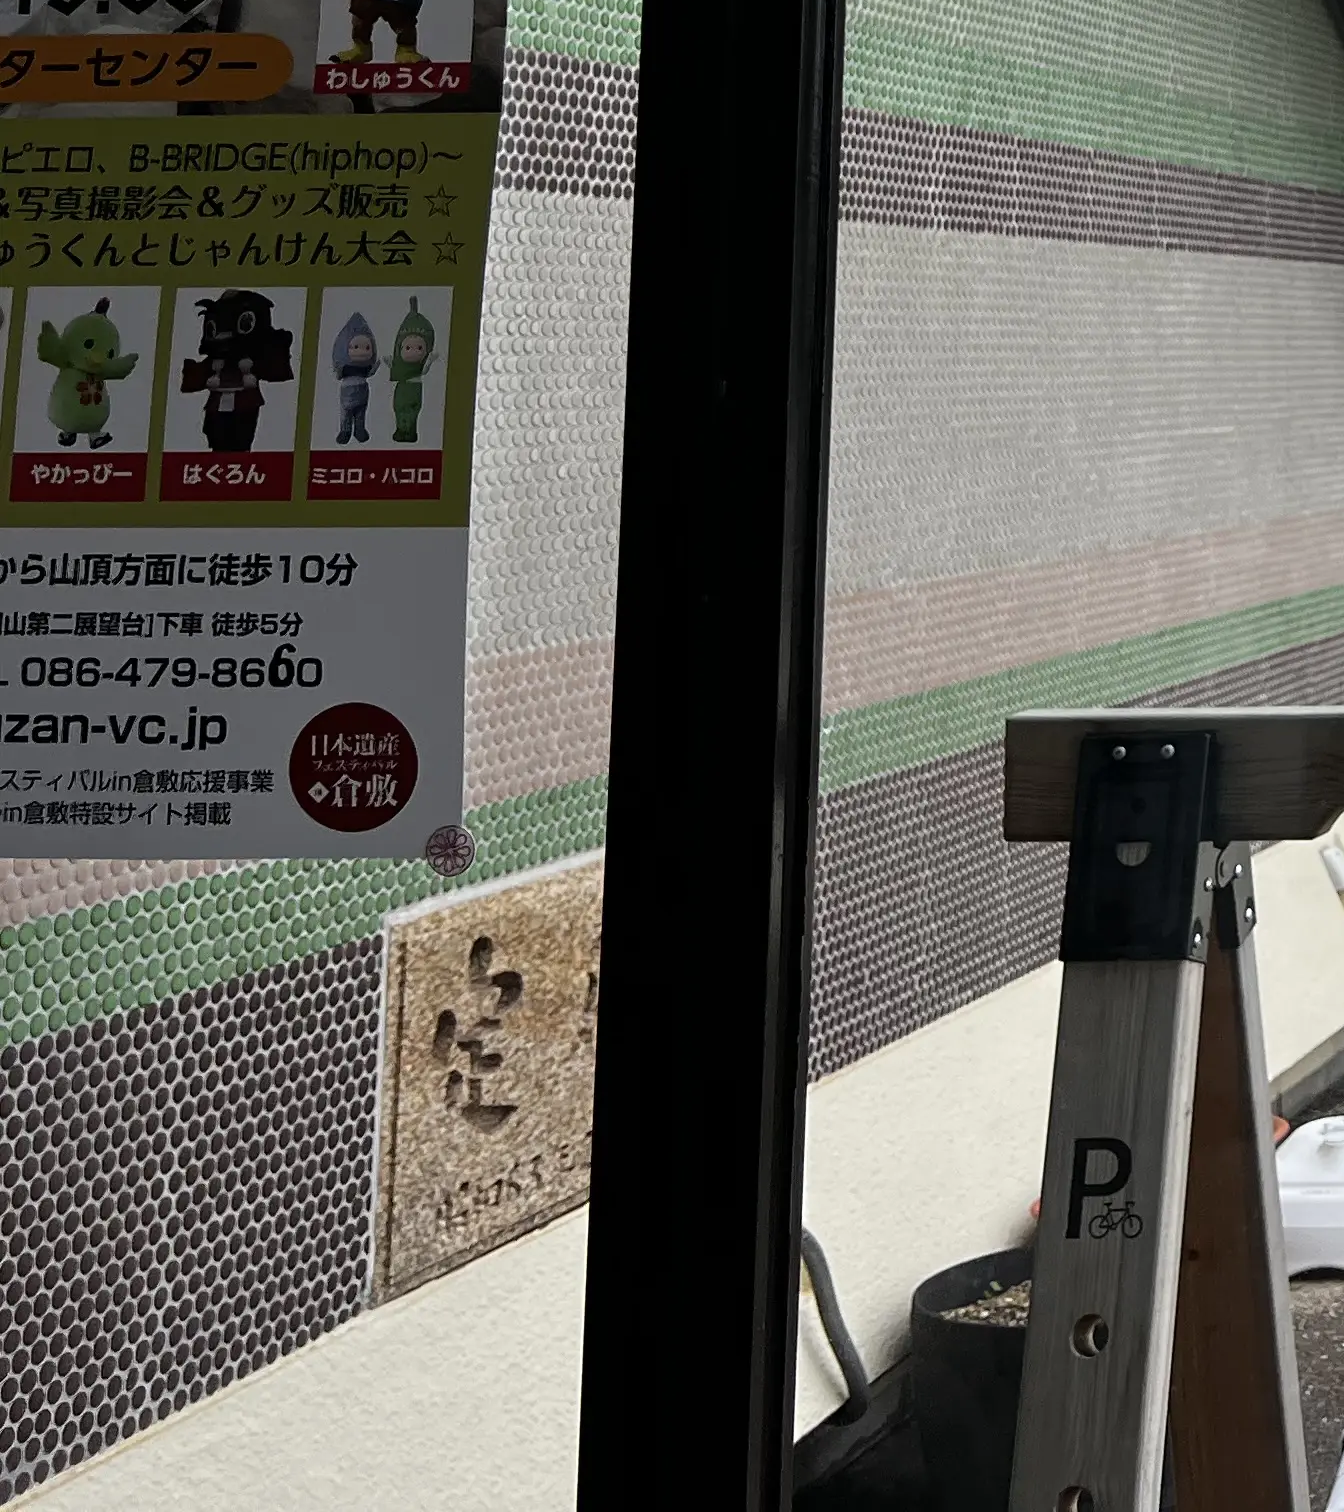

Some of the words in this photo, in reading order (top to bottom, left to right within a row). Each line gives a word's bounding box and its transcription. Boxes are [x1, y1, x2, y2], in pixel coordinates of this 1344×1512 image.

[326, 66, 461, 91] わしゅうくん
[29, 462, 134, 486] やかっぴー
[182, 462, 267, 487] はぐろん
[20, 642, 324, 689] 086-479-8660
[0, 704, 229, 752] zan-vc.jp
[1065, 1137, 1133, 1240] P
